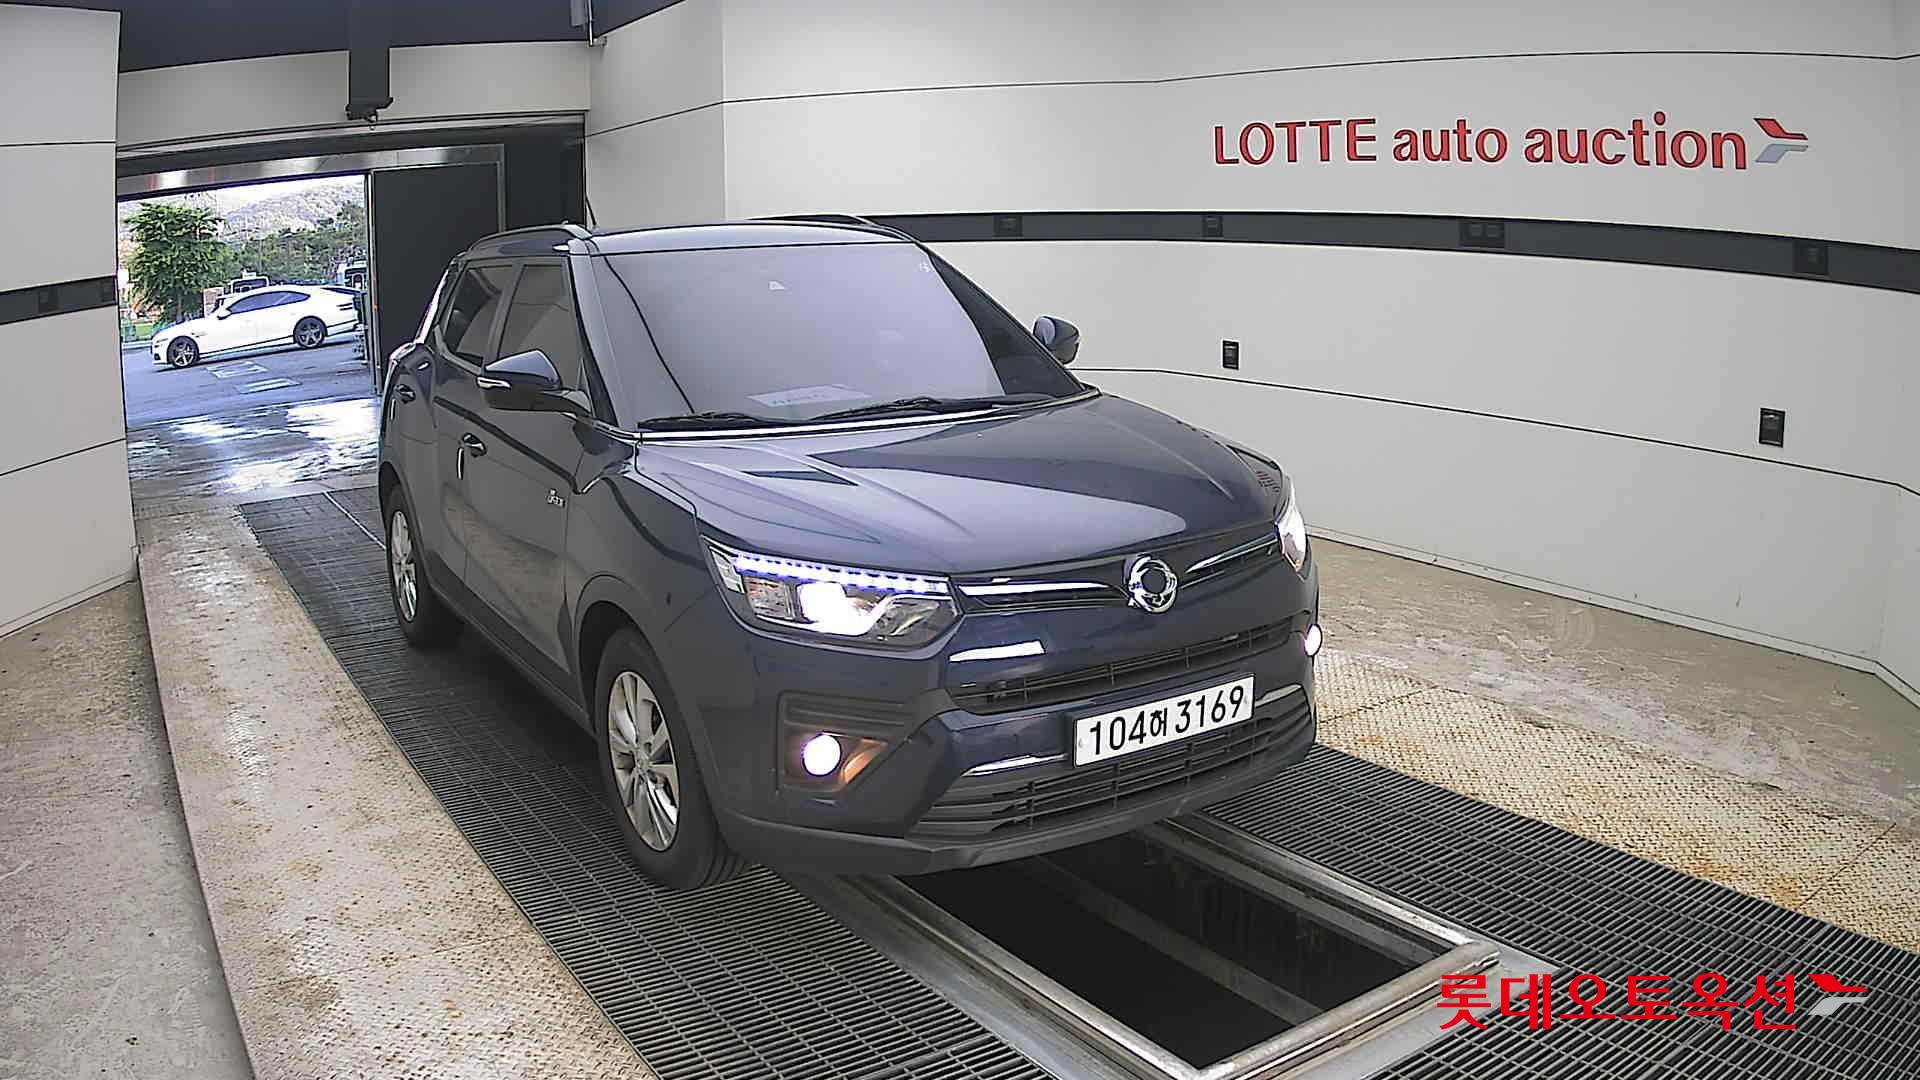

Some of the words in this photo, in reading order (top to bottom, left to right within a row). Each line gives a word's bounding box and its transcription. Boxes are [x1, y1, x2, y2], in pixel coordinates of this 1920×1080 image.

[1214, 118, 1377, 165] LOTTE
[1393, 119, 1508, 163] auto
[1524, 111, 1748, 170] auction
[1090, 707, 1168, 755] 104허
[1175, 685, 1244, 734] 3169
